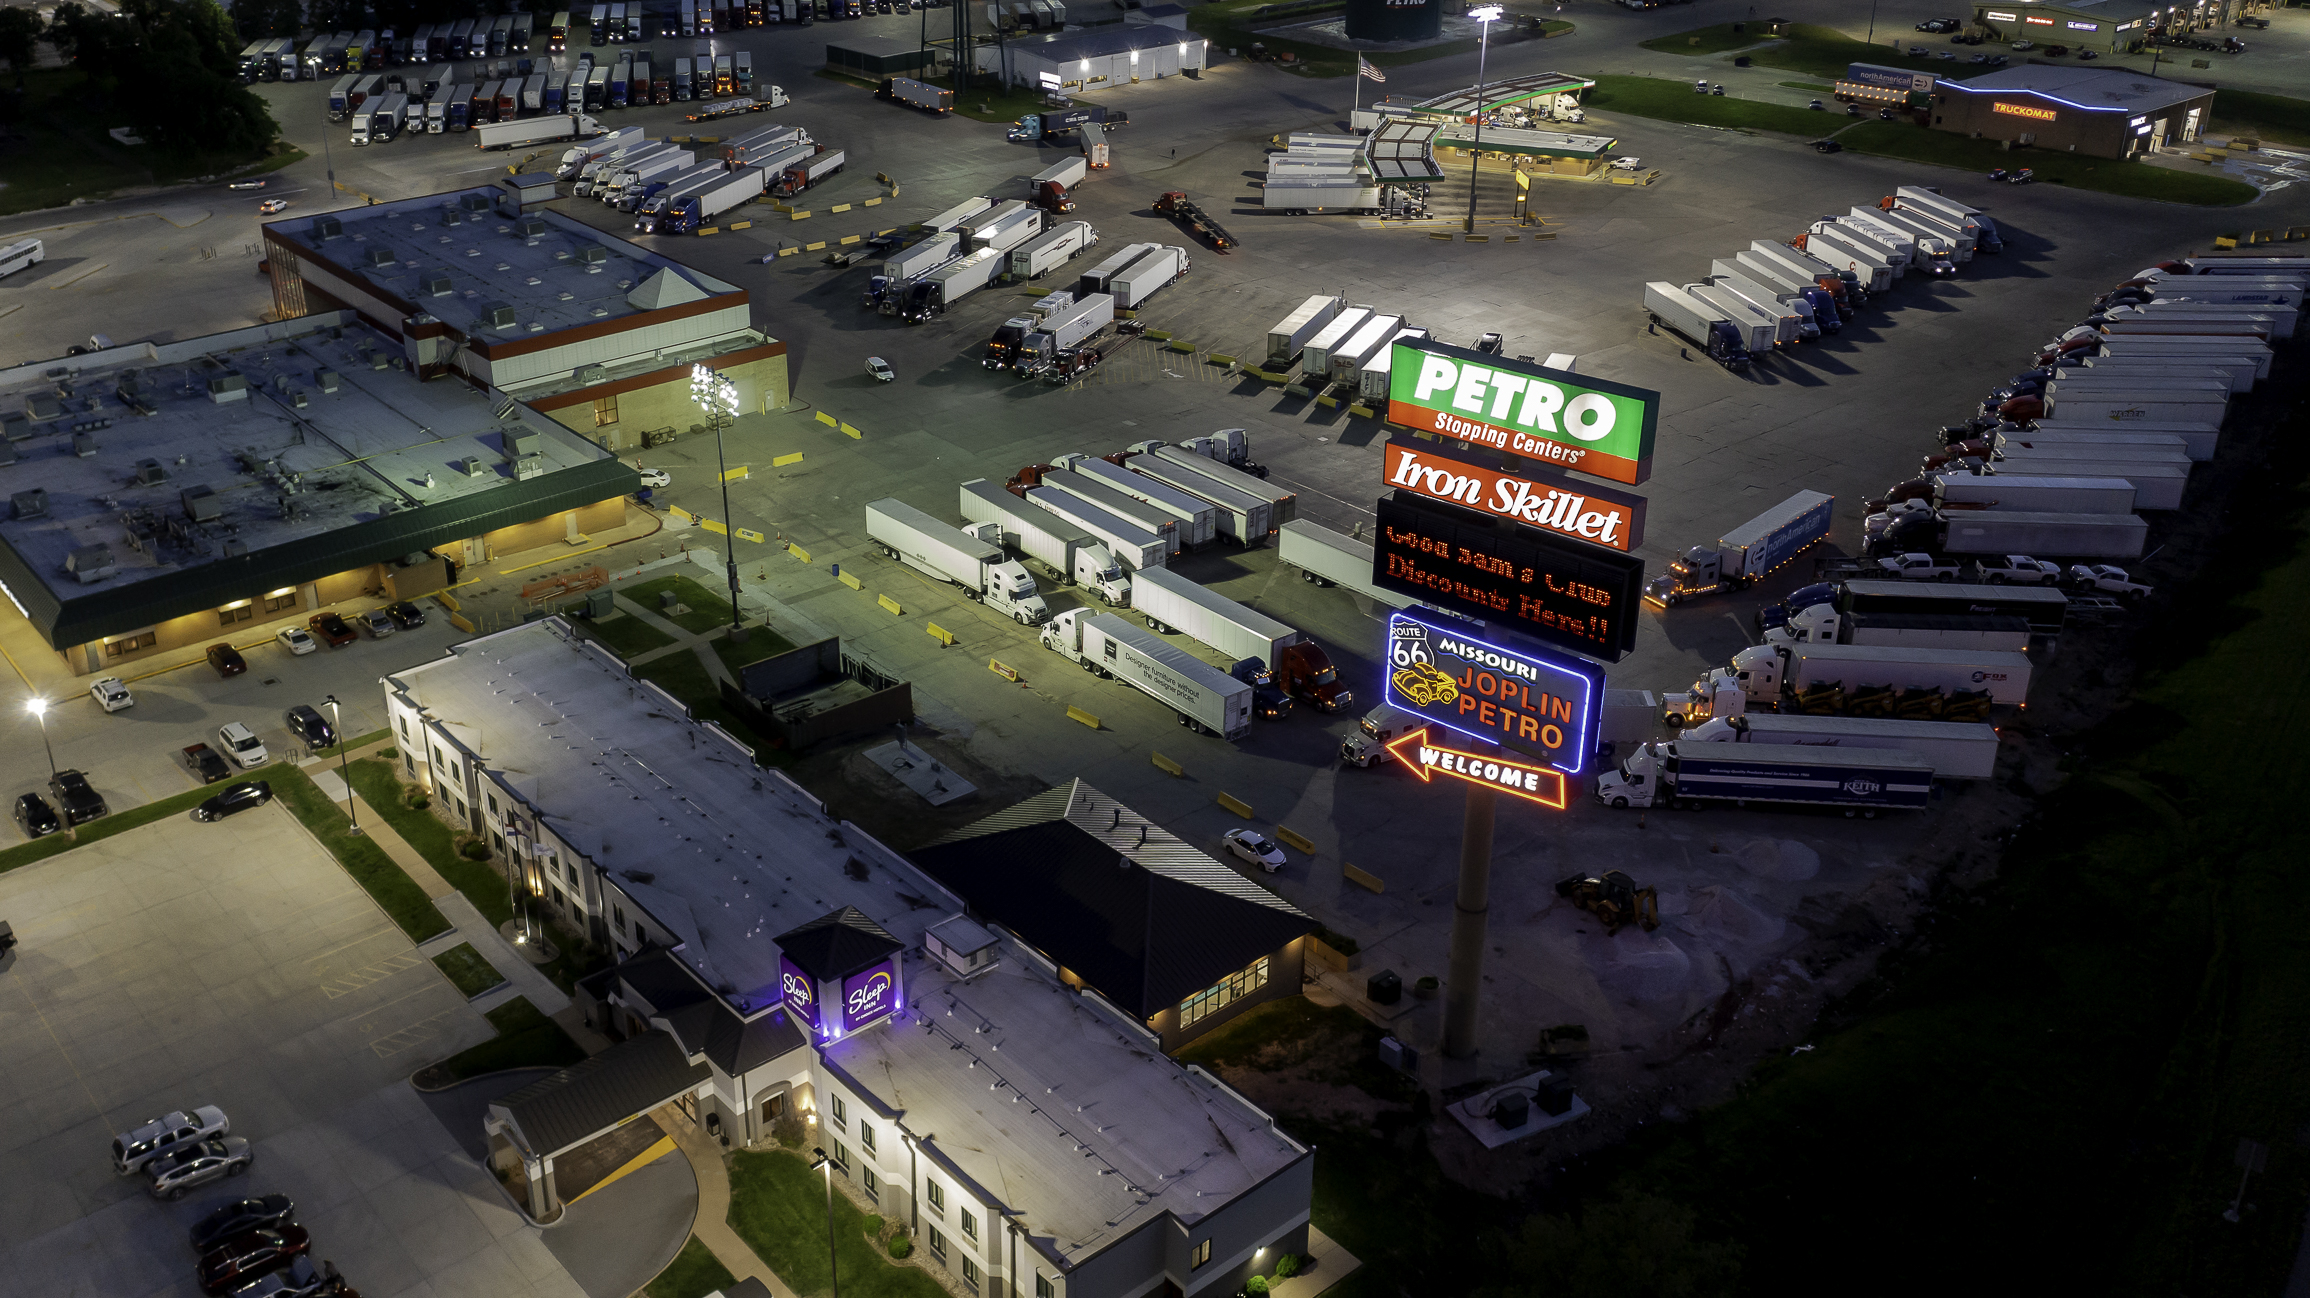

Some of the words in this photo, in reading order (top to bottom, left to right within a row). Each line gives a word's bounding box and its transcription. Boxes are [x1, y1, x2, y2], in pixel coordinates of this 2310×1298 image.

[1995, 103, 2055, 120] TRUCKOMAT
[1414, 355, 1616, 442] PETRO
[1434, 412, 1508, 448] Stopping
[1390, 450, 1480, 504] Iron
[1488, 478, 1622, 545] Skillet
[1768, 514, 1820, 553] northAmerican
[1386, 552, 1510, 612] Discounts
[1518, 594, 1608, 644] Here!!
[1392, 627, 1420, 637] ROUTE
[1393, 641, 1428, 667] 66
[1439, 638, 1537, 681] MISSOURI
[1126, 652, 1150, 672] Designer
[1152, 667, 1176, 686] furniture
[1177, 682, 1200, 699] without
[1143, 671, 1152, 680] the
[1154, 678, 1176, 694] designer
[1177, 690, 1196, 704] prices.
[1458, 667, 1572, 723] JOPLIN
[1459, 693, 1563, 749] PETRO
[1419, 747, 1539, 791] WELCOME
[1842, 782, 1880, 792] KEITH
[783, 973, 809, 1006] Sleep
[794, 996, 803, 1006] INN
[848, 982, 887, 1014] Sleep
[863, 1001, 876, 1011] INN
